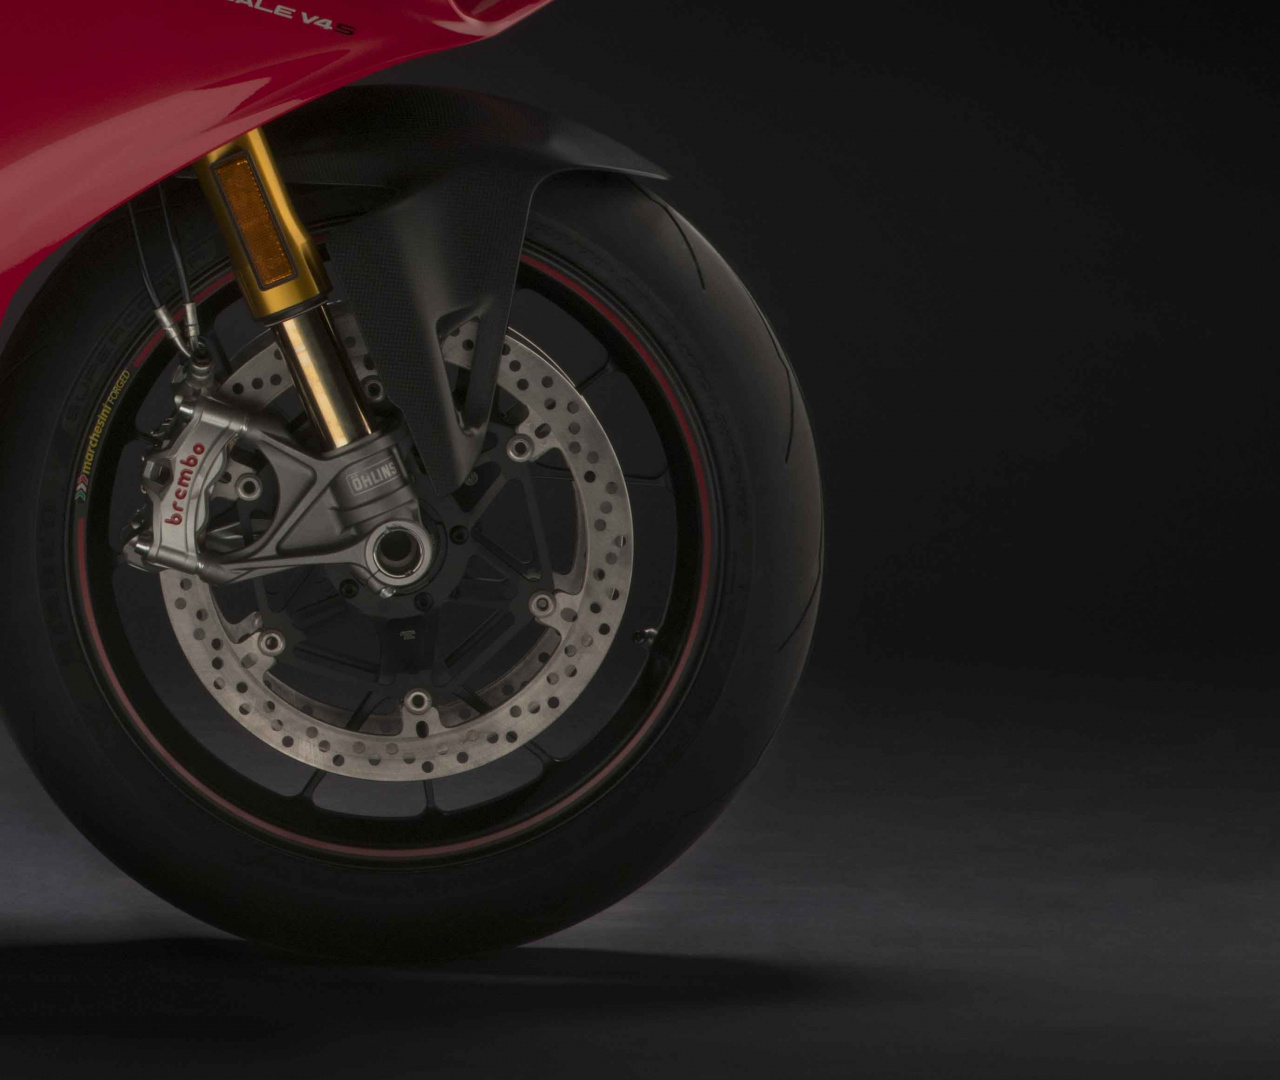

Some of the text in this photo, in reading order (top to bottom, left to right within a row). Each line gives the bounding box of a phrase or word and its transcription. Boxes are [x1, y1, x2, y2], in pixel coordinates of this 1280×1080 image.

[82, 403, 113, 475] marchesini
[107, 370, 131, 405] FORGED
[164, 442, 206, 526] brembo
[350, 461, 398, 492] ÖHLINS
